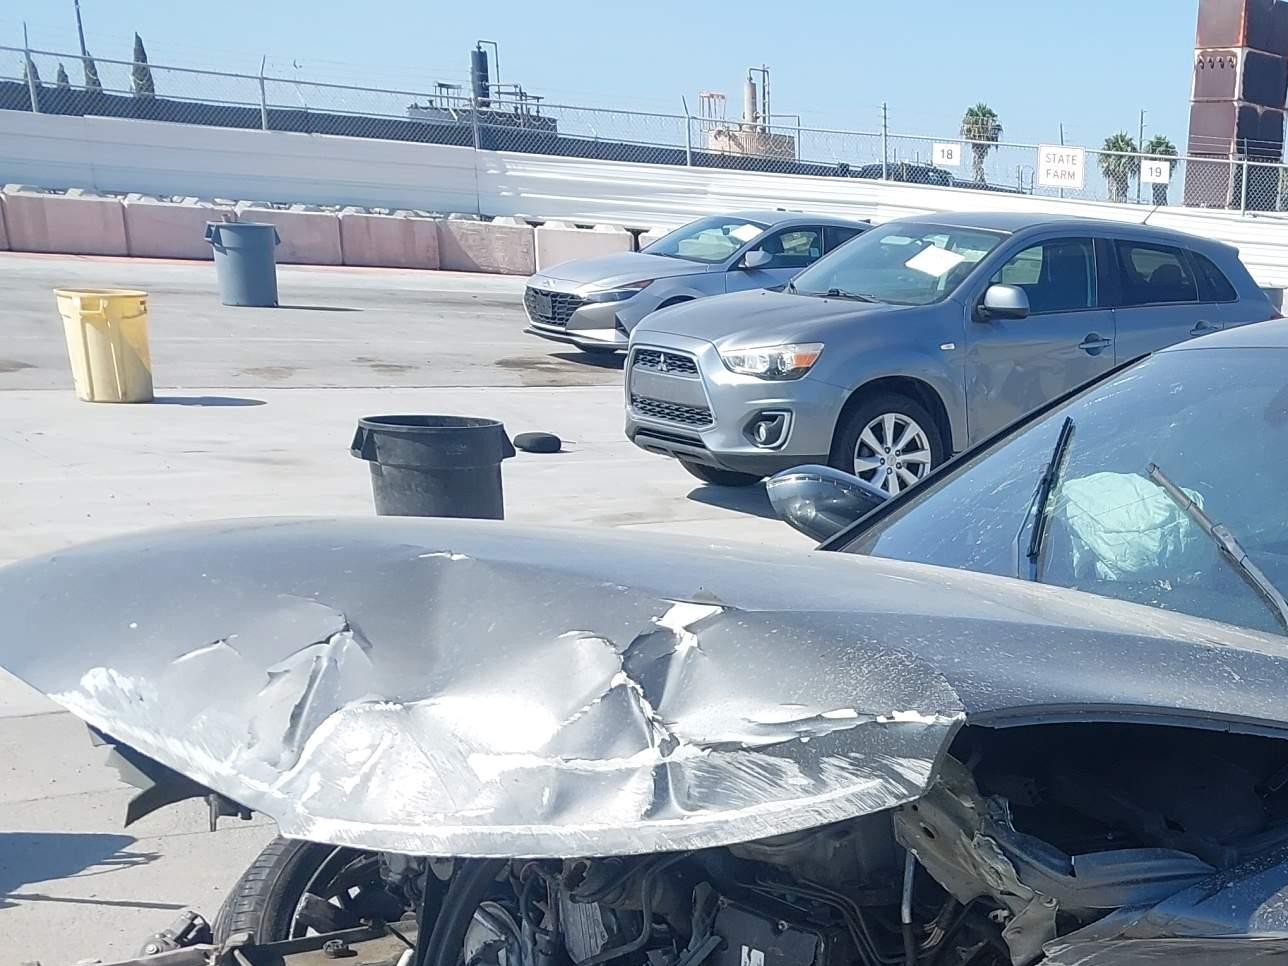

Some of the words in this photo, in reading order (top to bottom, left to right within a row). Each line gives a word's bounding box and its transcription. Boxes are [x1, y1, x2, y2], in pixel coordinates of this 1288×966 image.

[940, 149, 953, 160] 18
[1045, 153, 1077, 166] STATE
[1045, 168, 1076, 181] FARM
[1149, 166, 1162, 178] 19
